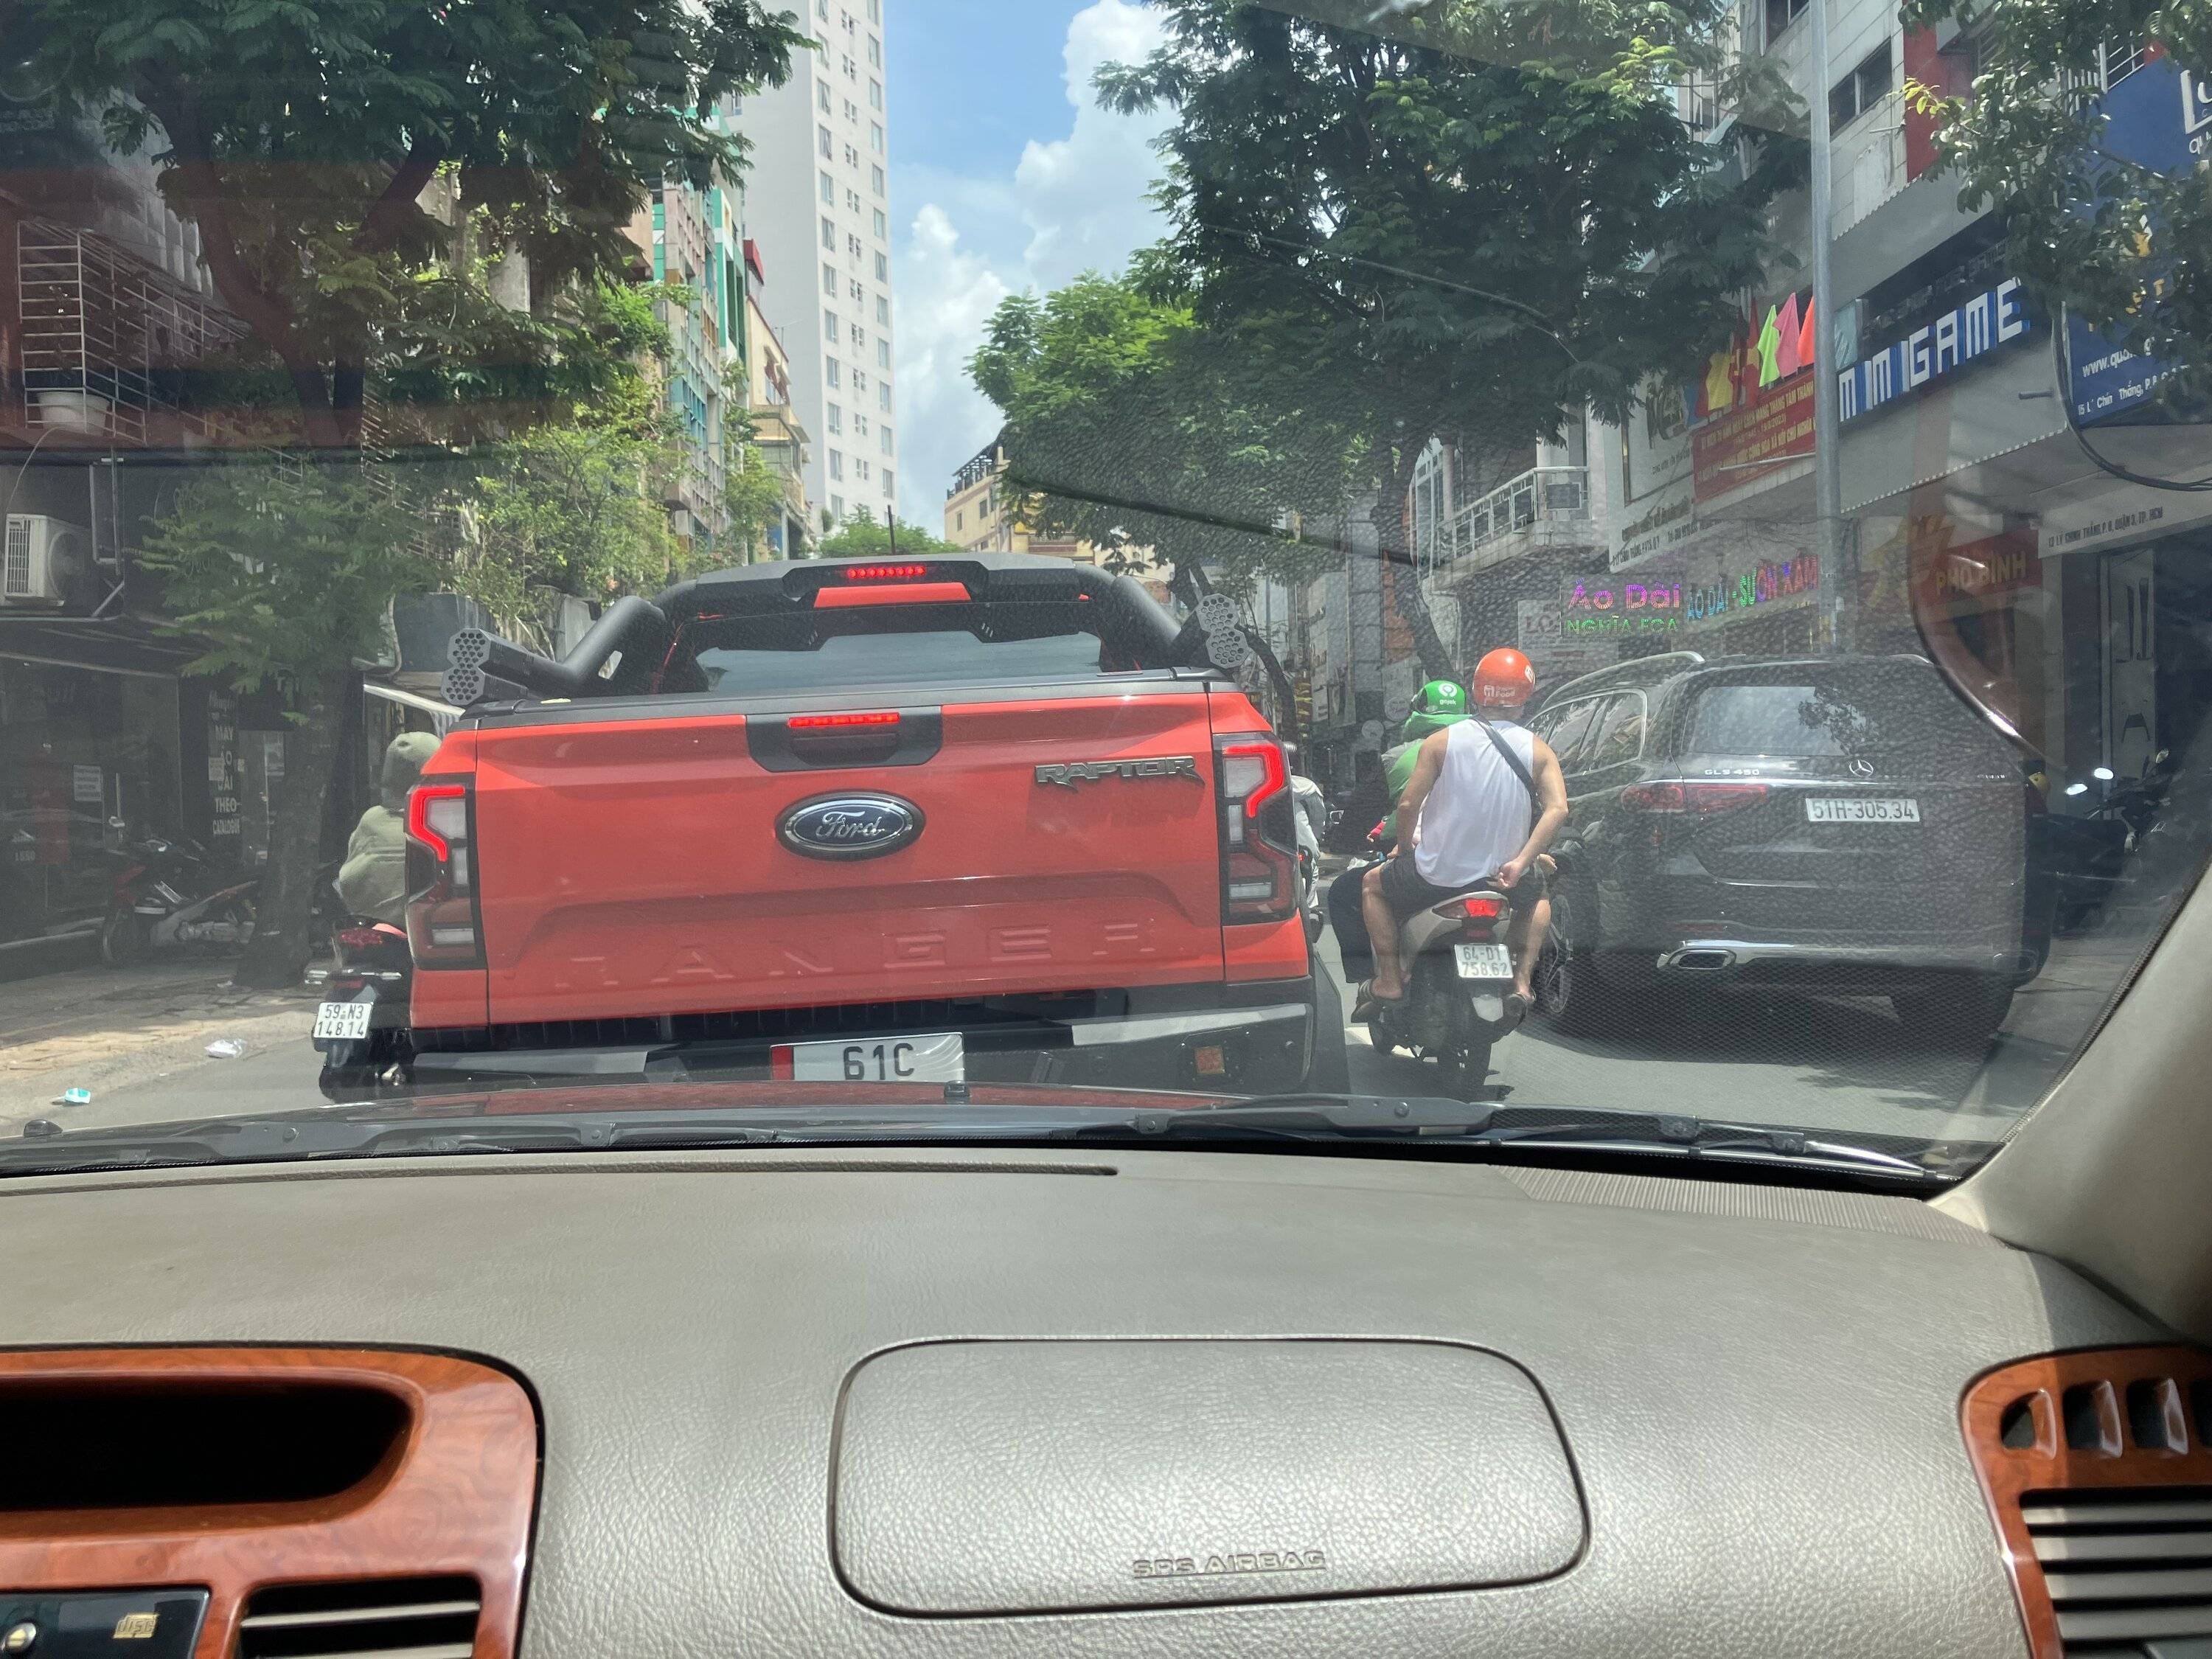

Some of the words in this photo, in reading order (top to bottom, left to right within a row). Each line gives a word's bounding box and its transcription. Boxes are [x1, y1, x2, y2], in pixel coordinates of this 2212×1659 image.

[1568, 577, 1614, 610] Áo
[1626, 580, 1680, 609] Dài
[1439, 698, 1457, 706] gojek
[1035, 755, 1206, 793] RAPTOR
[1812, 800, 1915, 820] 51H-305.34
[815, 810, 885, 839] Ford
[318, 1021, 364, 1037] 148.14
[843, 1042, 915, 1081] 61C
[1133, 1557, 1196, 1576] SRS
[1205, 1550, 1326, 1572] AIRBAG
